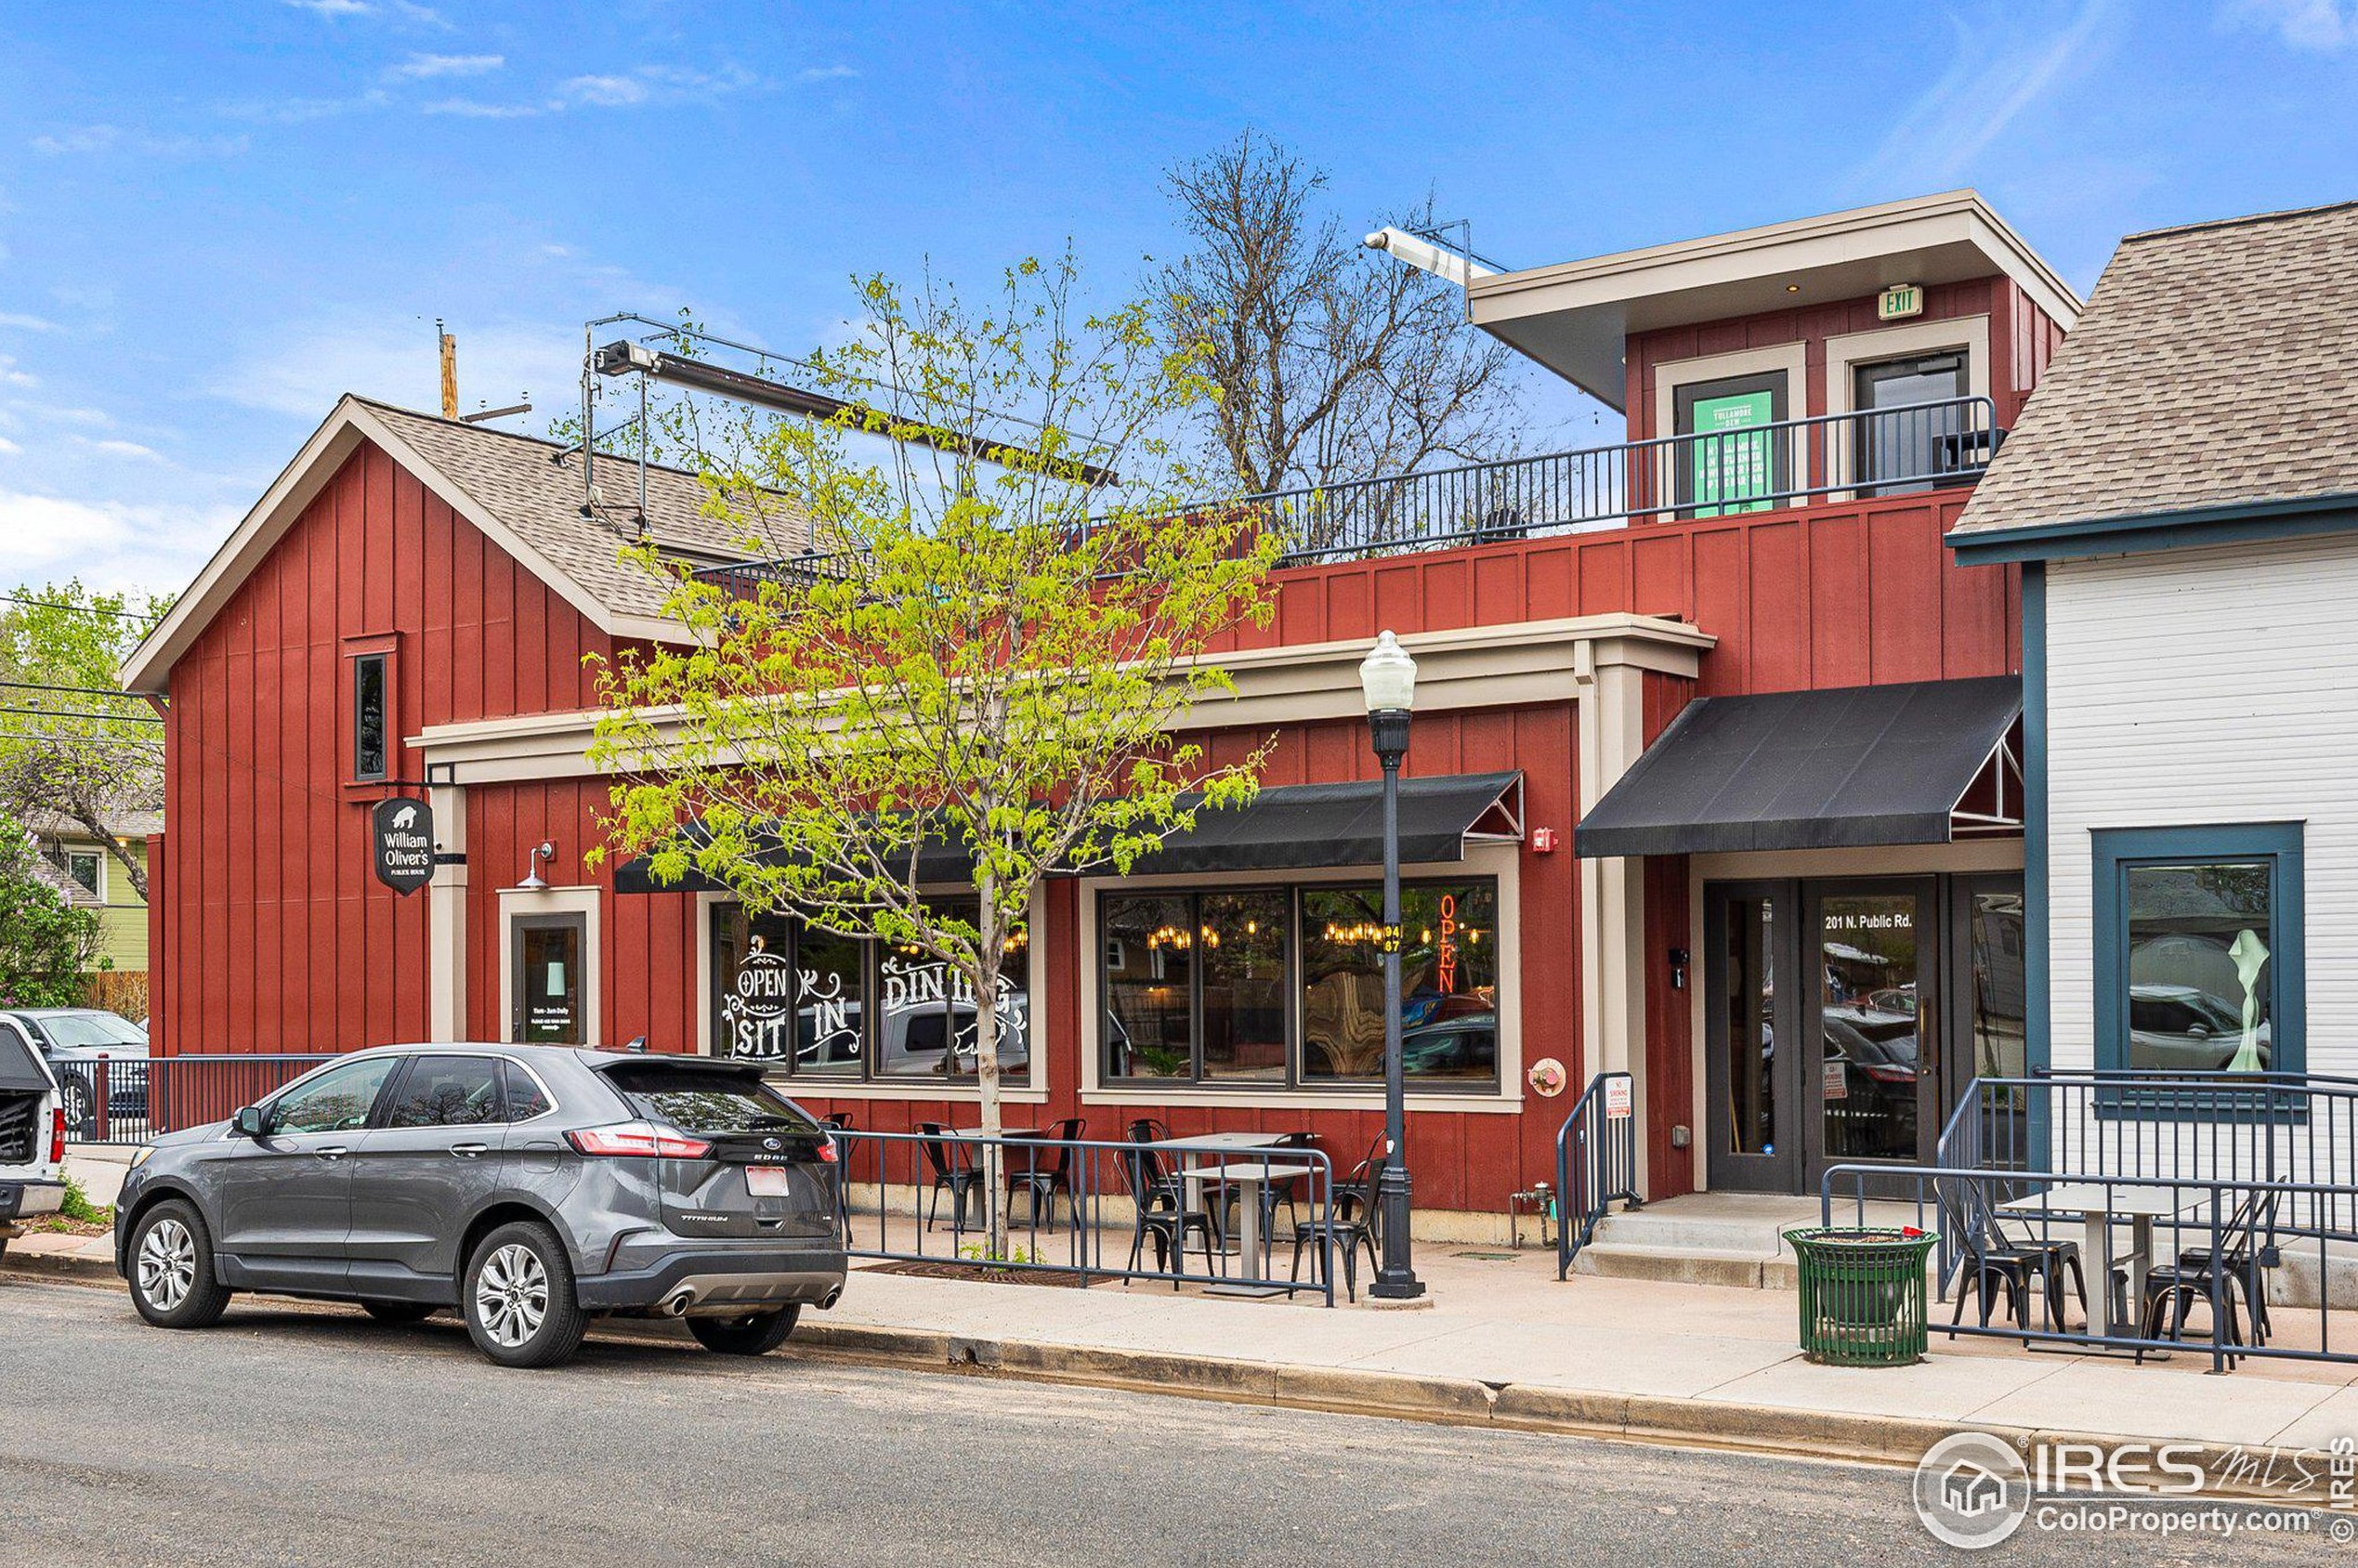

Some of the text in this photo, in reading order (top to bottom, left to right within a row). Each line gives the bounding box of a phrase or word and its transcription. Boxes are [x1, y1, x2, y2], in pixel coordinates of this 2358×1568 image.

[1887, 290, 1914, 314] EXIT
[384, 831, 427, 848] William
[386, 849, 428, 866] Oliver's
[1826, 914, 1912, 929] 201 N. Public Rd.
[1439, 895, 1456, 993] OPEN
[738, 969, 786, 997] OPEN
[737, 997, 848, 1055] SIT IN
